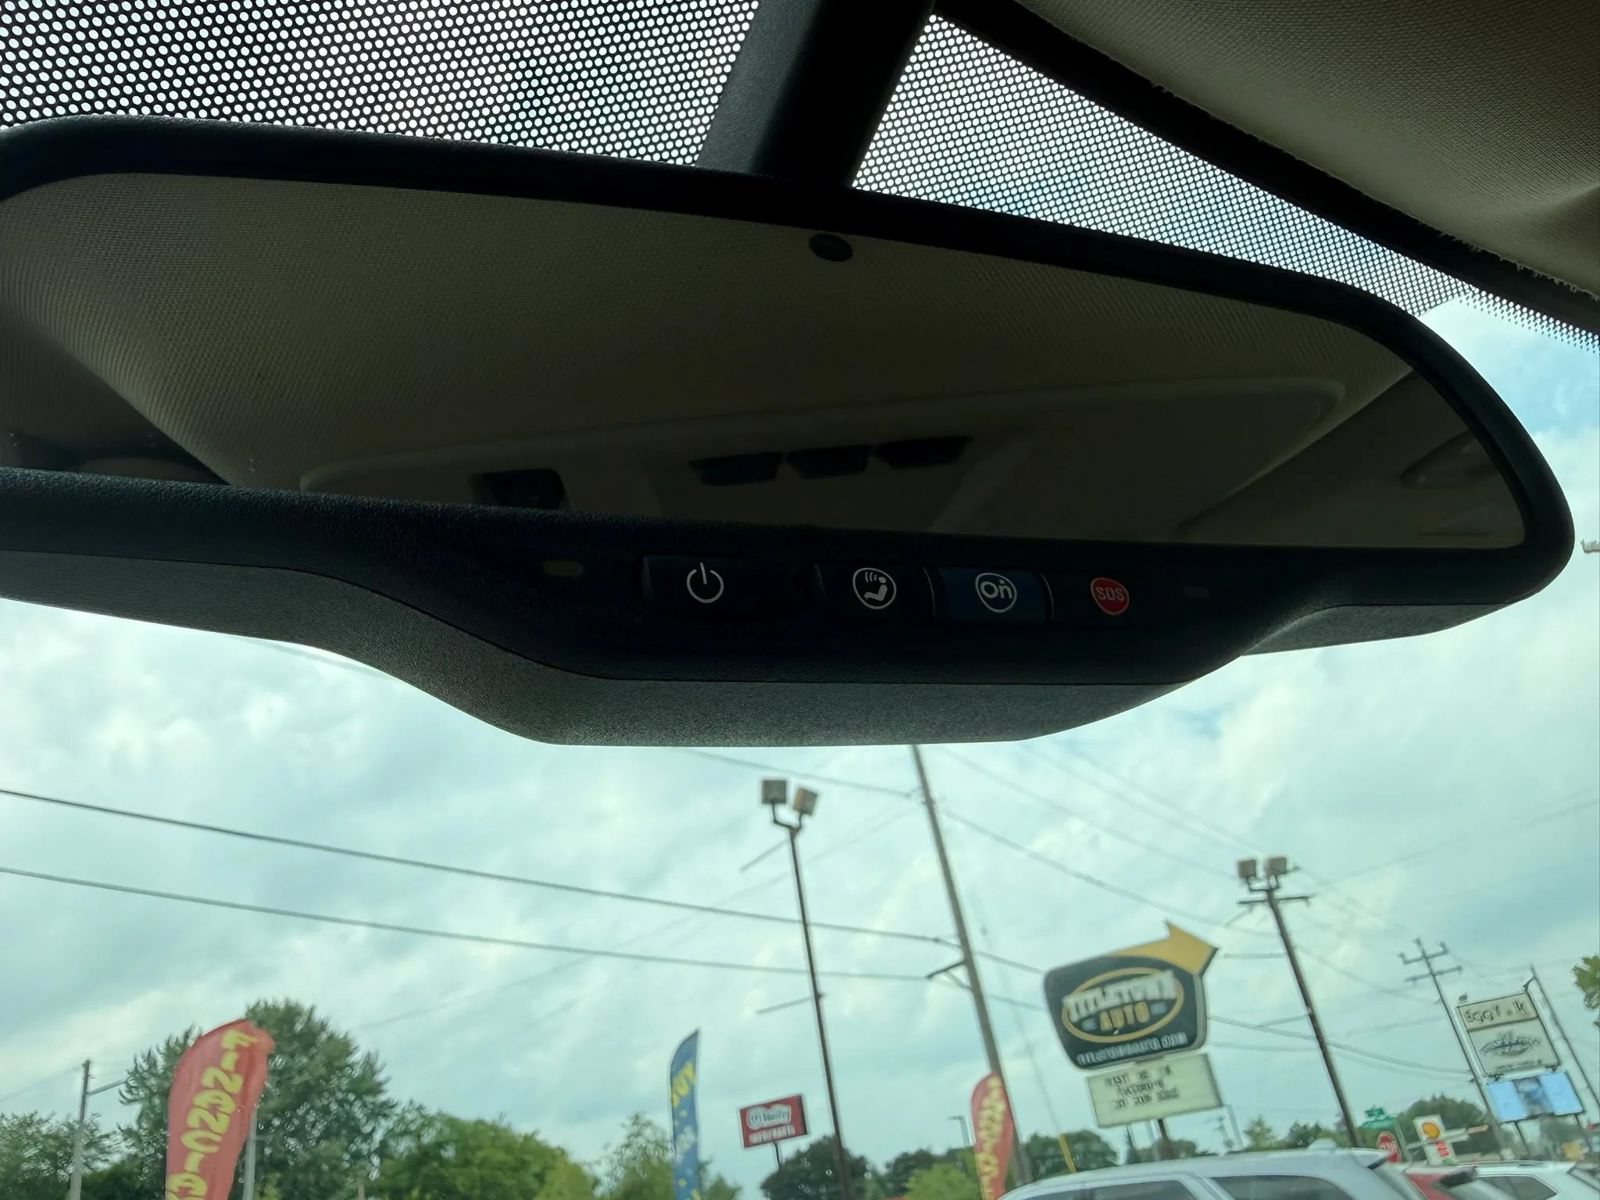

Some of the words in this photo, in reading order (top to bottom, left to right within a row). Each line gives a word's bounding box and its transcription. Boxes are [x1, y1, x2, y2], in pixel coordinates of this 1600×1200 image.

[980, 579, 1013, 600] On
[1095, 586, 1125, 602] SOS
[1099, 1001, 1150, 1032] AUTO
[167, 1029, 258, 1200] FINANCIA
